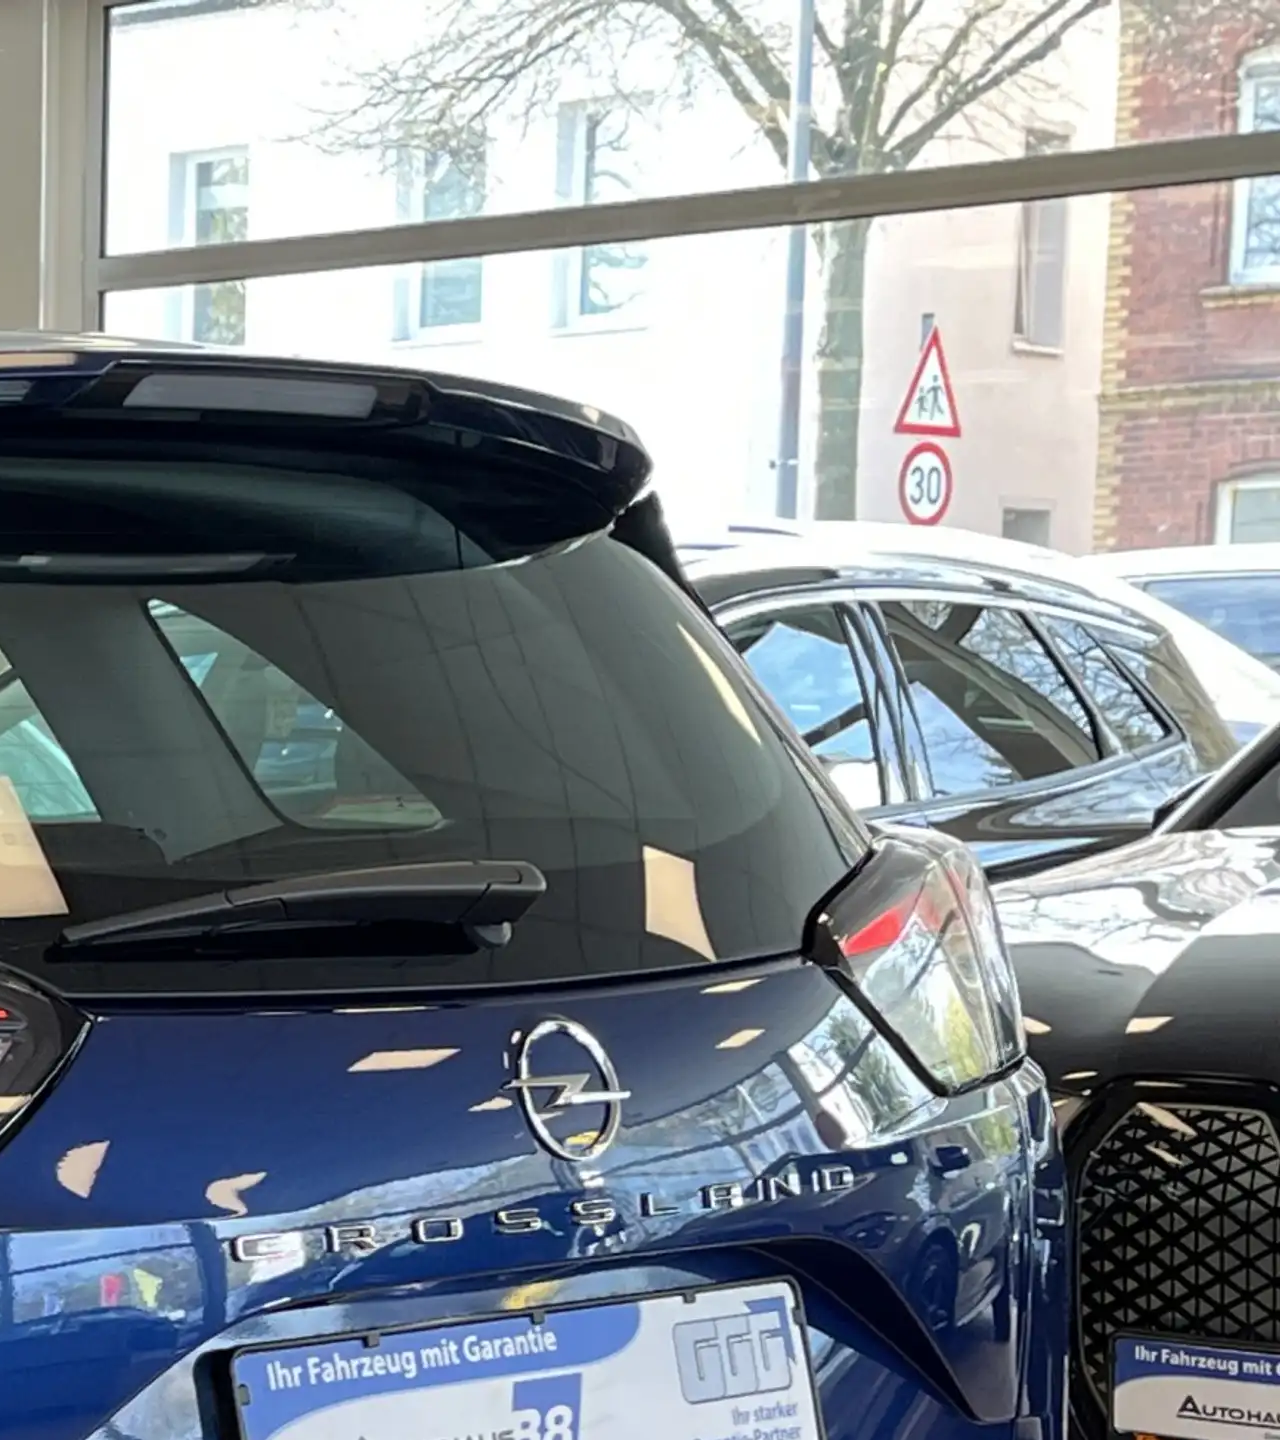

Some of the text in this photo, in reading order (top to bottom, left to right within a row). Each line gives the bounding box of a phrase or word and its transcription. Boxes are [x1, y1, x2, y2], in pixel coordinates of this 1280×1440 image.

[909, 466, 941, 505] 30
[233, 1164, 856, 1263] CROSSLAND
[266, 1326, 557, 1391] Ihr Fahrzeug mit Garantie
[1134, 1345, 1156, 1363] Ihr
[1161, 1349, 1238, 1375] Fahrzeug
[1243, 1360, 1273, 1375] mit
[754, 1402, 798, 1422] starker
